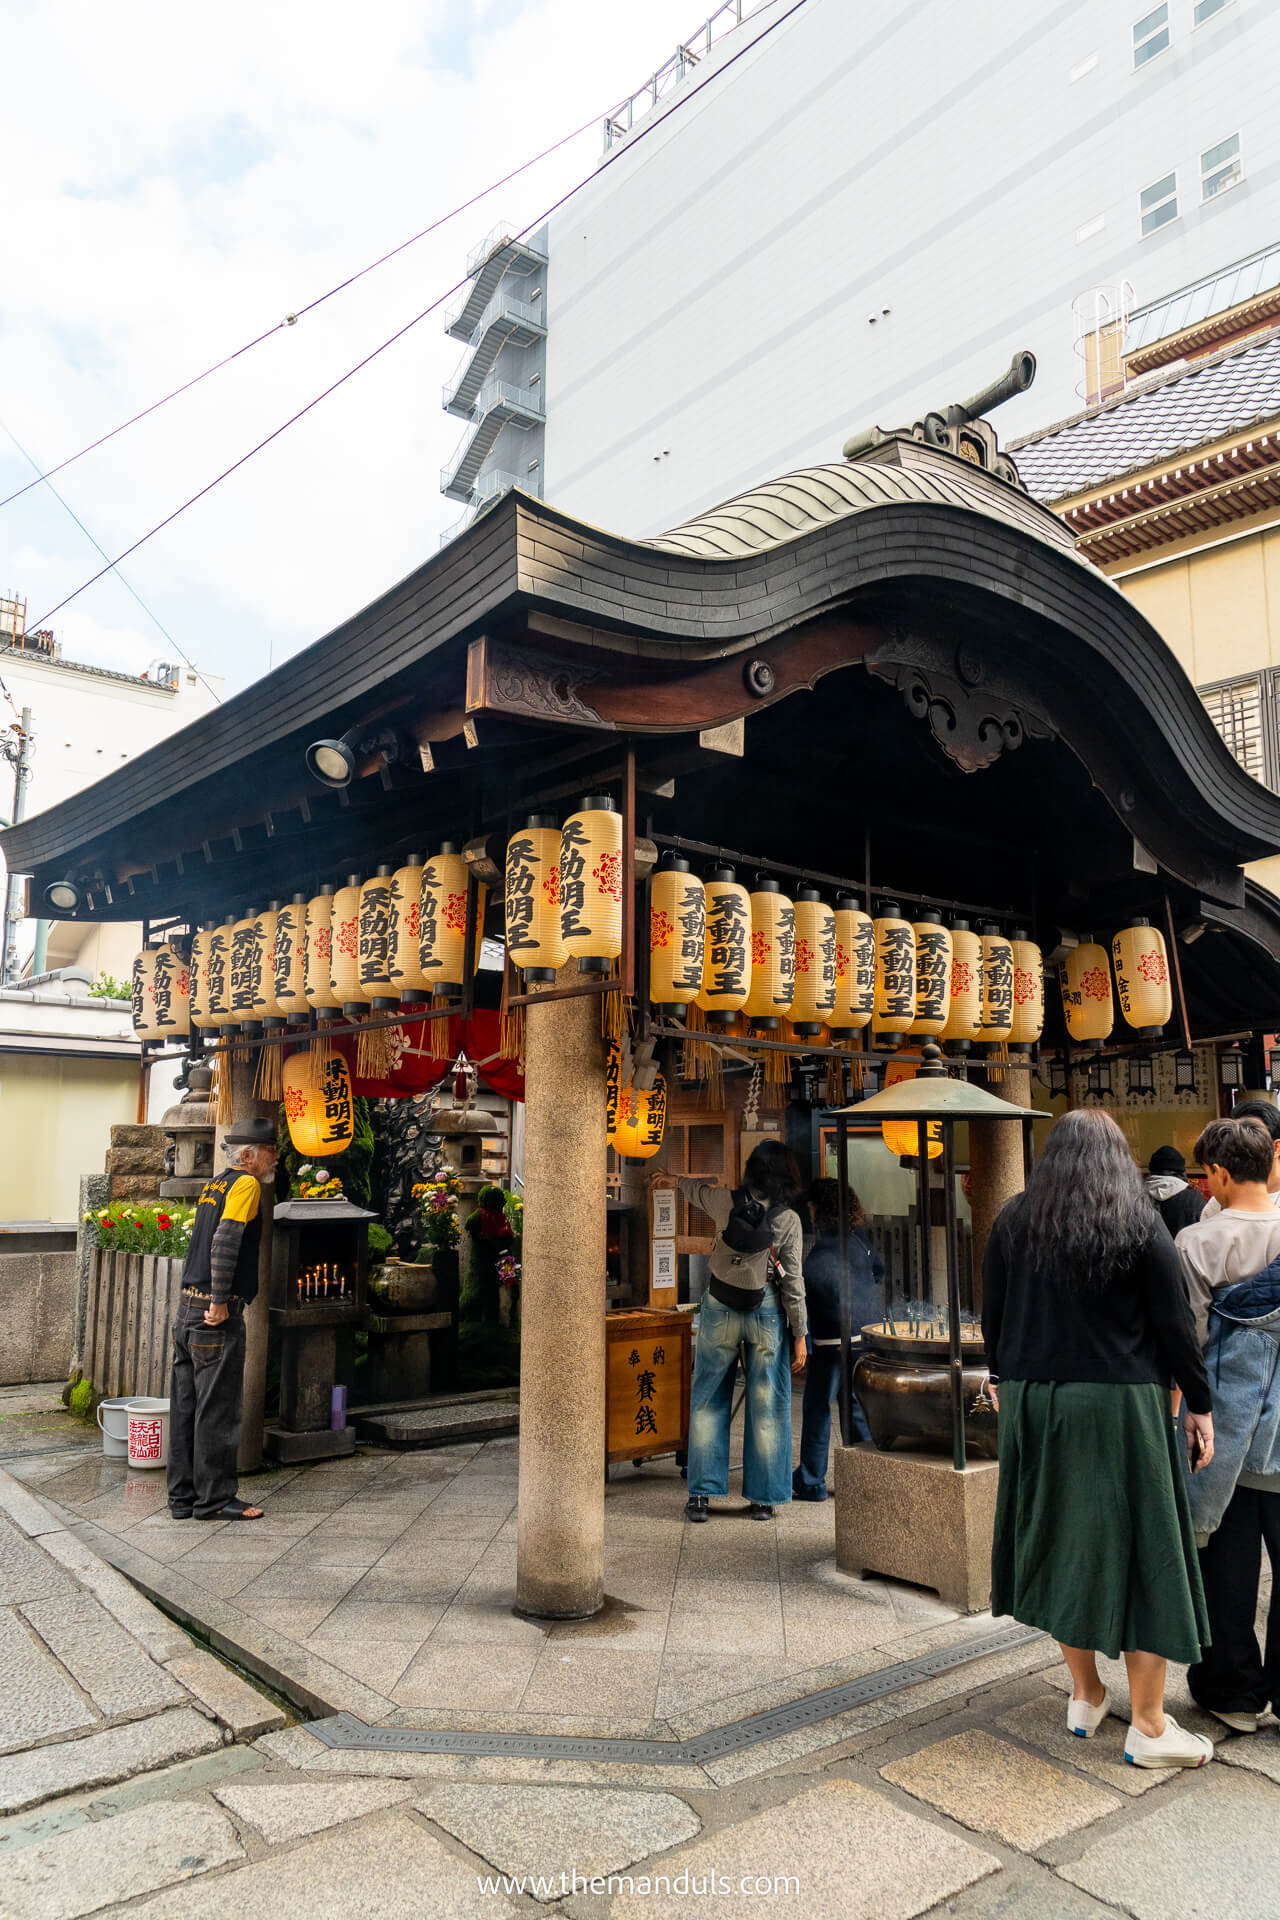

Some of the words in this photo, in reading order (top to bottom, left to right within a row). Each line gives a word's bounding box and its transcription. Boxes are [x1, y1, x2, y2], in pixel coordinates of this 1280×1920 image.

[419, 866, 443, 969] 不動明王
[506, 838, 541, 951] 不動明王
[560, 820, 592, 940] 不動明王
[208, 934, 230, 1014] 不動明王
[230, 927, 254, 1011] 不動明王
[274, 911, 297, 997] 不動明王
[360, 886, 391, 986] 不動明王
[672, 886, 706, 990] 不動明王
[706, 893, 748, 996] 不動明王
[850, 921, 875, 1014] 不動明王
[879, 927, 914, 1018] 不動明王
[914, 932, 950, 1021] 不動明王
[154, 952, 177, 1026] 不動明王
[982, 945, 1014, 1029] 不動明王
[319, 1058, 353, 1144] 不動明王
[640, 1078, 666, 1146] 不動明王
[628, 1344, 665, 1369] 奉納
[147, 1421, 160, 1458] 千日前
